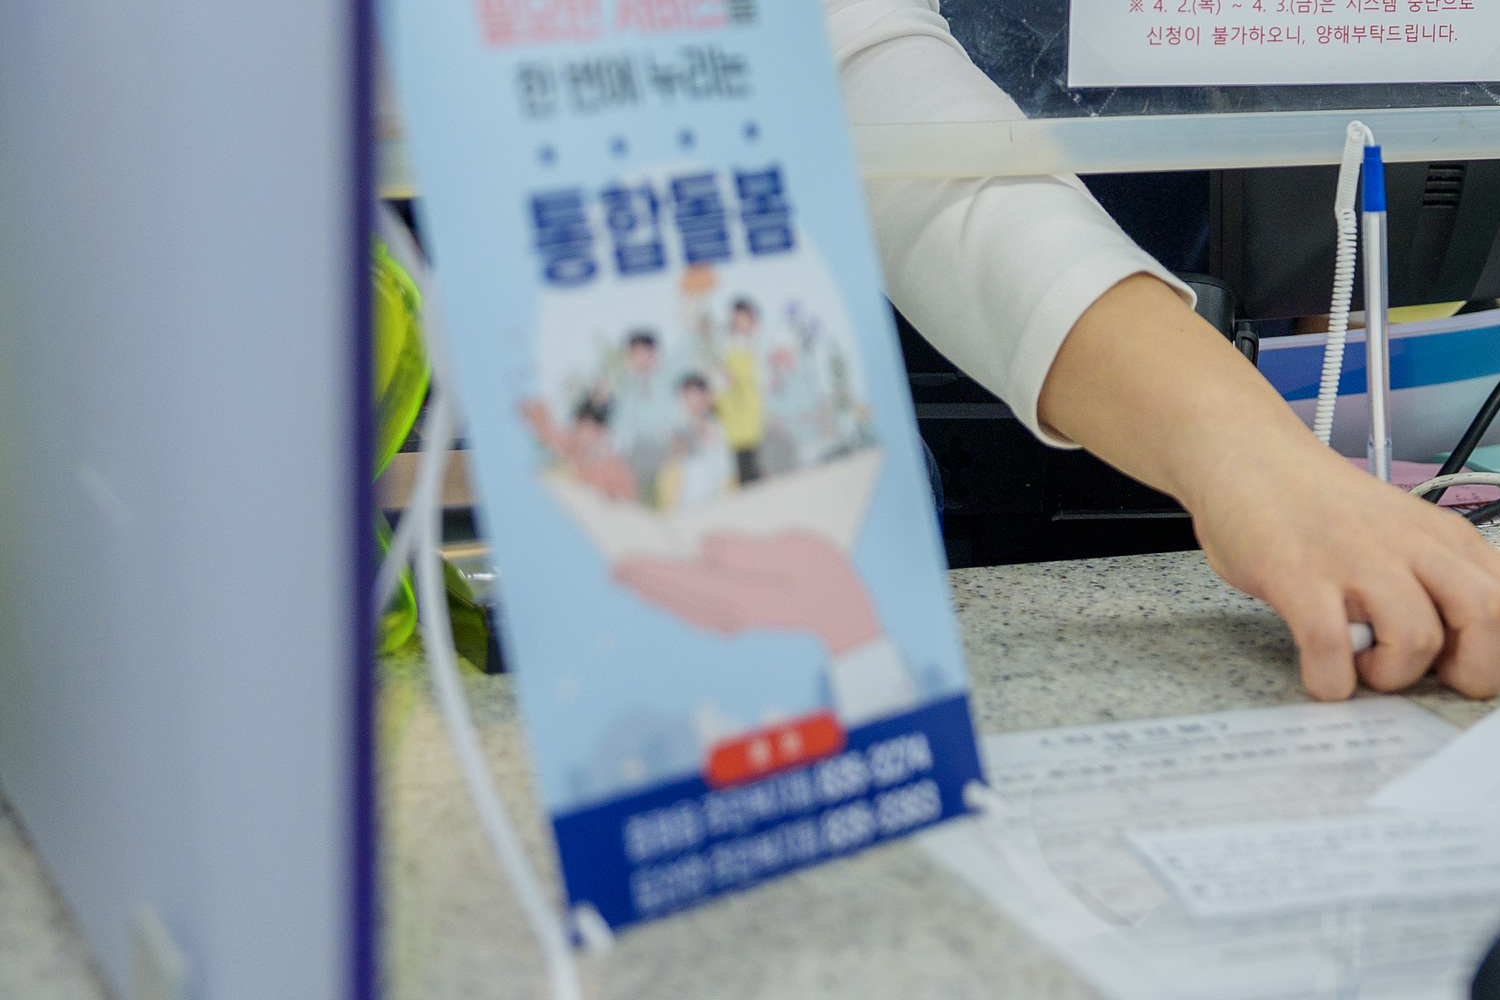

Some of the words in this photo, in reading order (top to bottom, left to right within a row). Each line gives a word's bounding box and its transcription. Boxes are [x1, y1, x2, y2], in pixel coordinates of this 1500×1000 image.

[1146, 25, 1200, 46] 신청이
[1211, 24, 1305, 46] 불가하오니,
[1316, 23, 1458, 45] 양해부탁드립니다.
[528, 162, 796, 287] 통합돌봄
